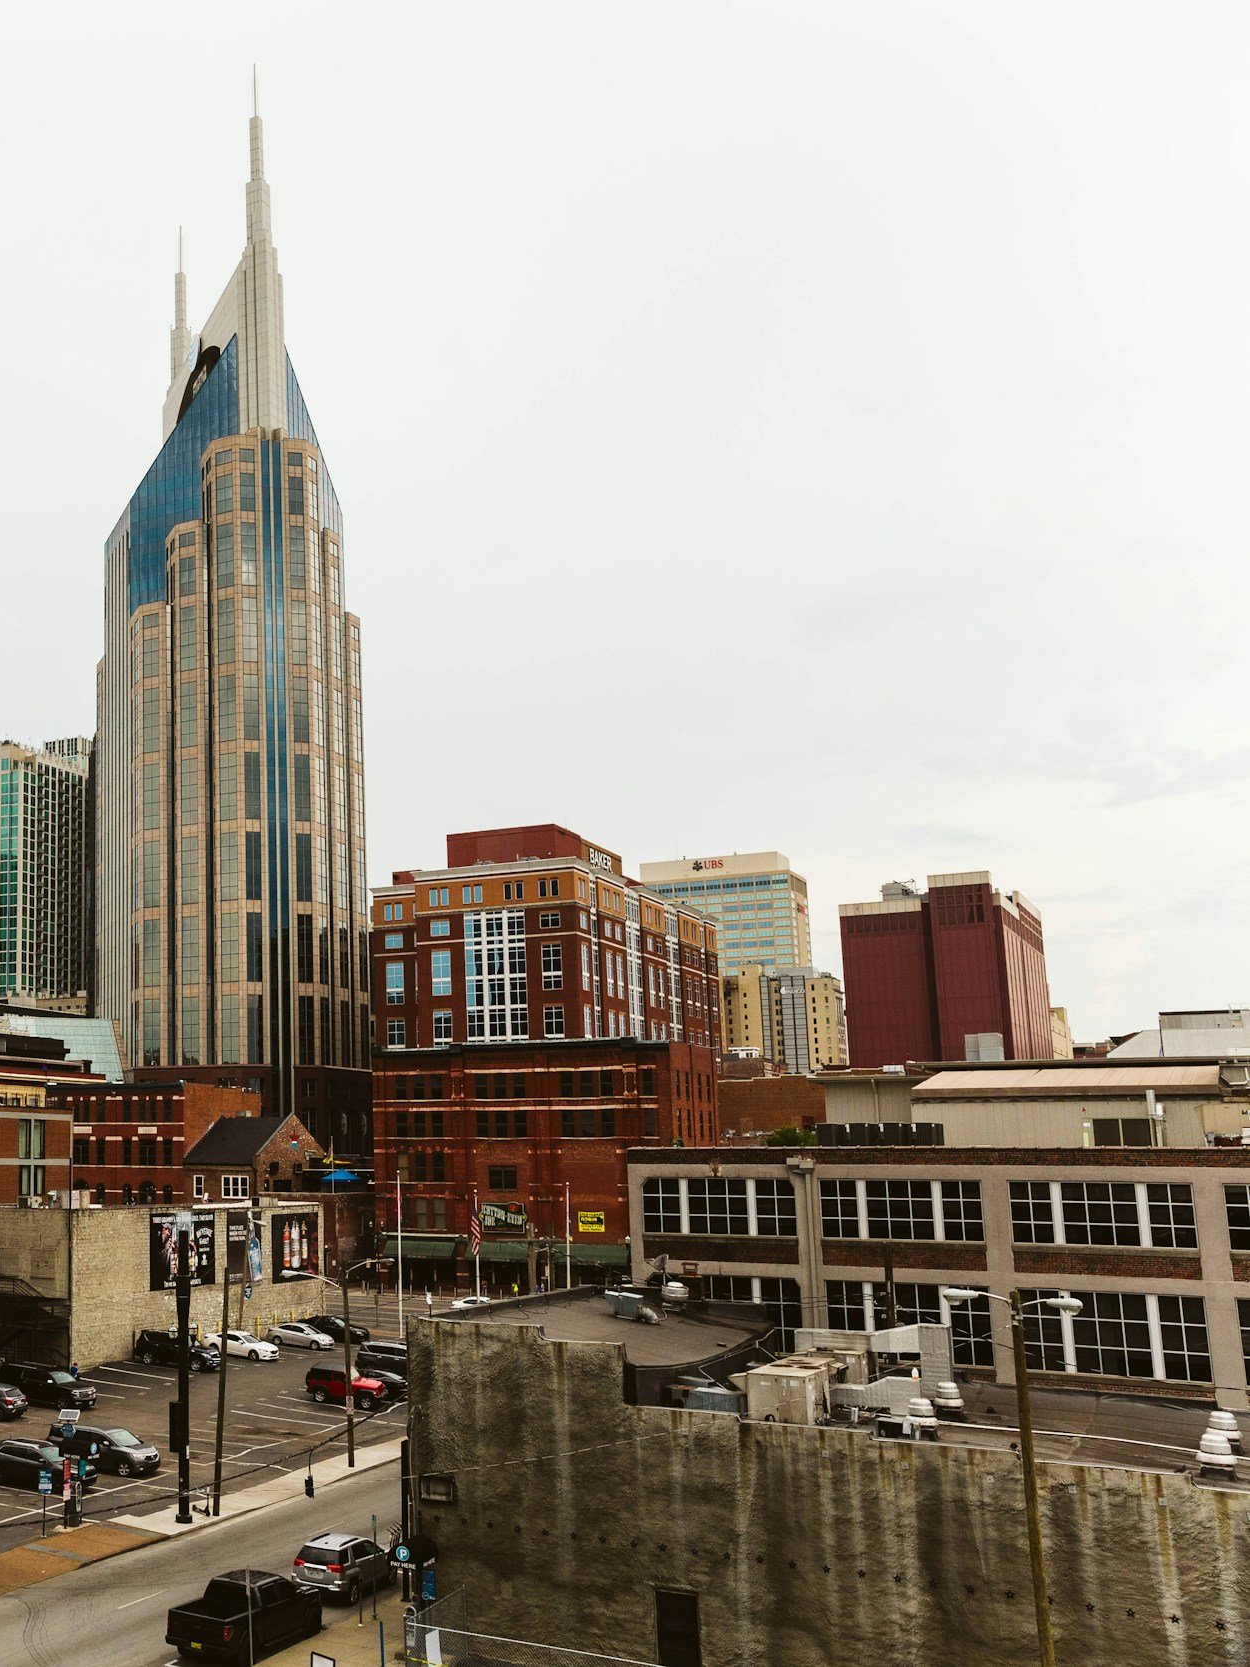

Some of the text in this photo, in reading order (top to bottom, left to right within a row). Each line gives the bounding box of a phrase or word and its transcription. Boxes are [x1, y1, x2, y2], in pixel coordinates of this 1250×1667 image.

[588, 847, 613, 873] BAKER
[703, 859, 724, 870] UBS
[390, 1560, 400, 1568] PAY
